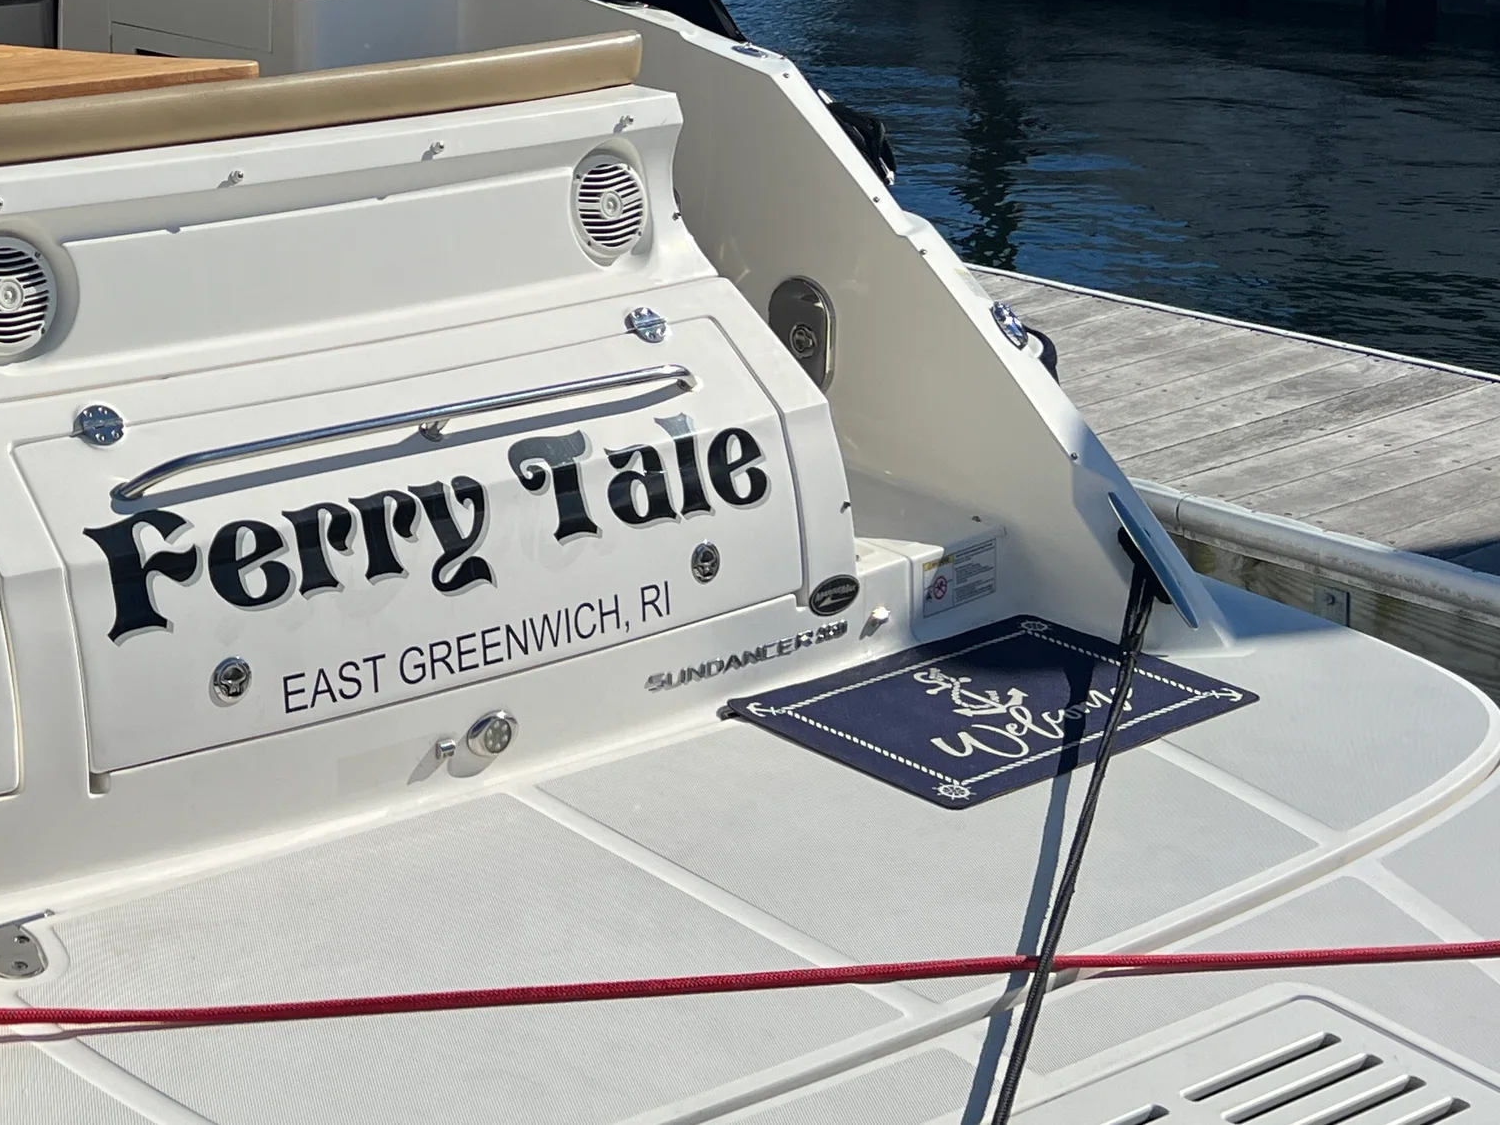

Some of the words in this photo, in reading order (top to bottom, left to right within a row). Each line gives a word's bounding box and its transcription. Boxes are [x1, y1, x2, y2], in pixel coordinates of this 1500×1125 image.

[82, 475, 499, 647] Ferry
[508, 412, 772, 545] Tale
[281, 653, 396, 714] EAST
[399, 594, 631, 686] GREENWICH,
[640, 580, 671, 623] RI
[644, 630, 814, 693] SUNDANCER
[930, 687, 1133, 758] Welcome
